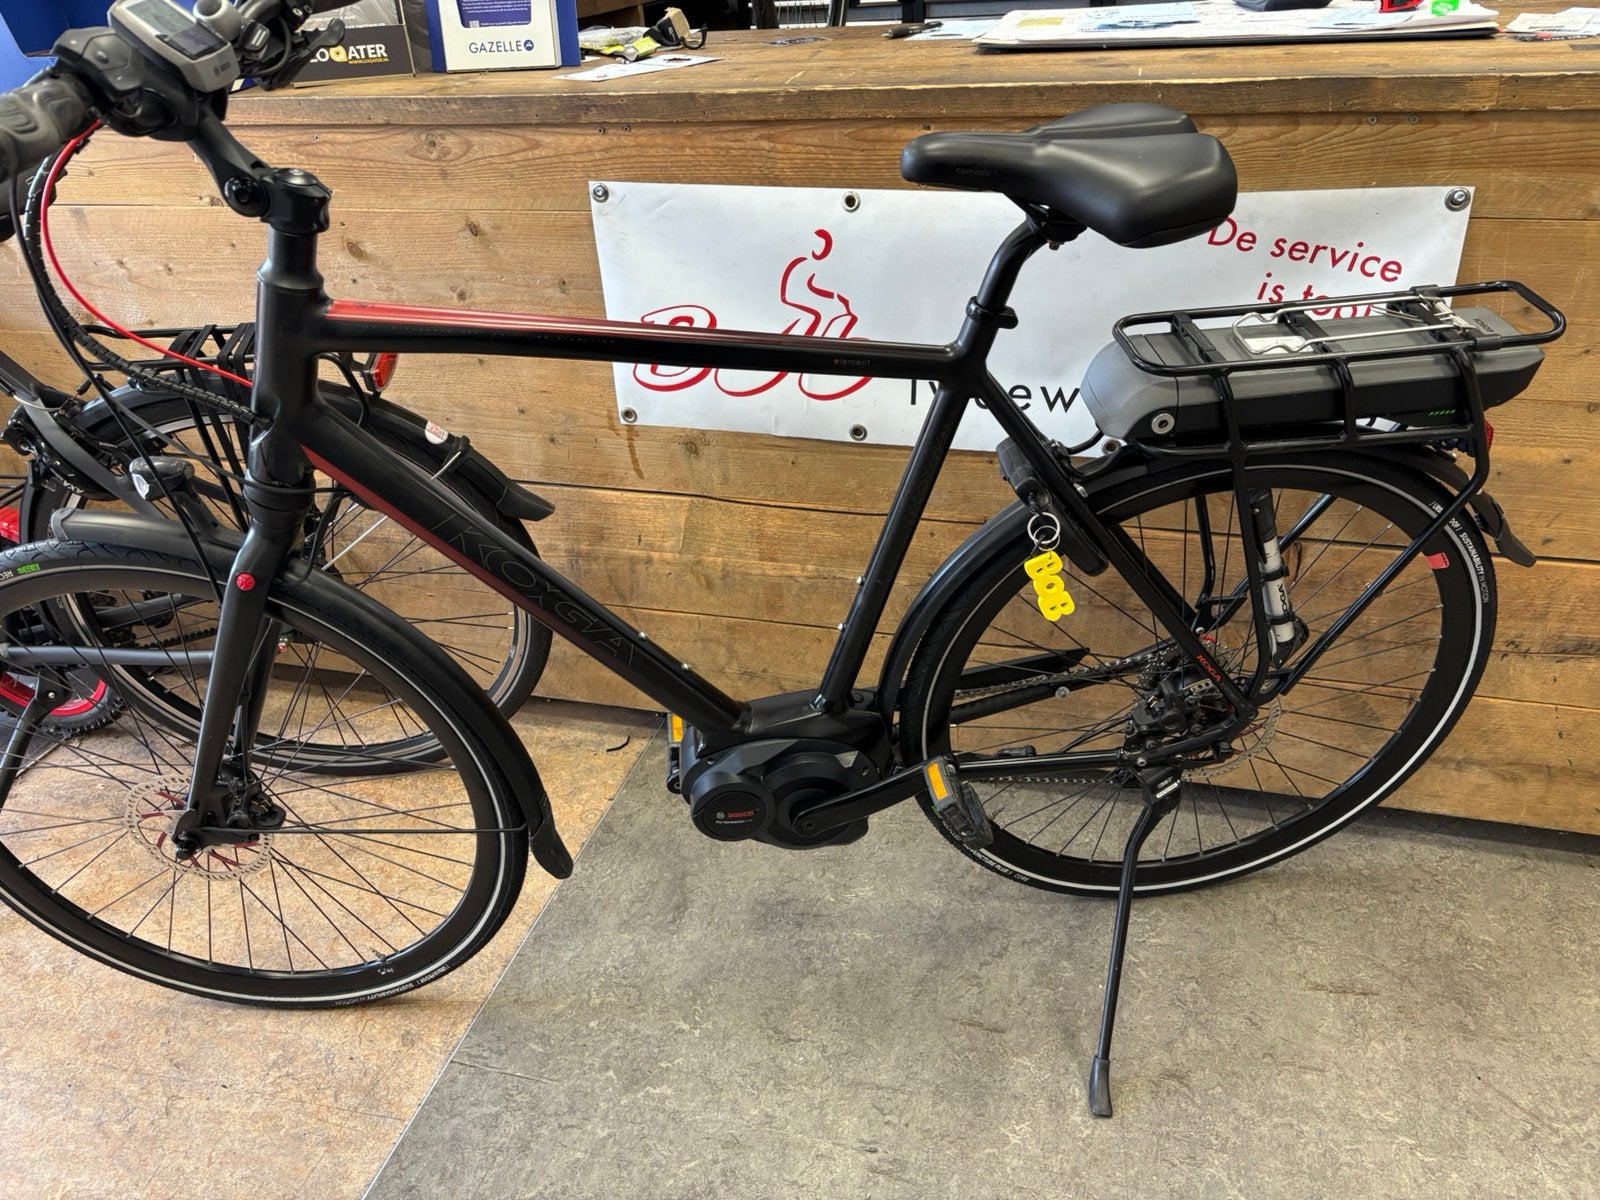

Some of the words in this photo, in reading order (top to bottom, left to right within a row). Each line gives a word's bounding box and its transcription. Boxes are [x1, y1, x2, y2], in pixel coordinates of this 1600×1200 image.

[310, 43, 388, 63] OQATER
[468, 40, 522, 54] GAZELLE
[1207, 215, 1257, 252] De
[1270, 237, 1403, 283] service
[1257, 272, 1285, 304] is
[833, 357, 871, 367] element
[1024, 550, 1076, 622] BOB
[1196, 654, 1222, 682] KOGA
[728, 810, 754, 819] BOSCH
